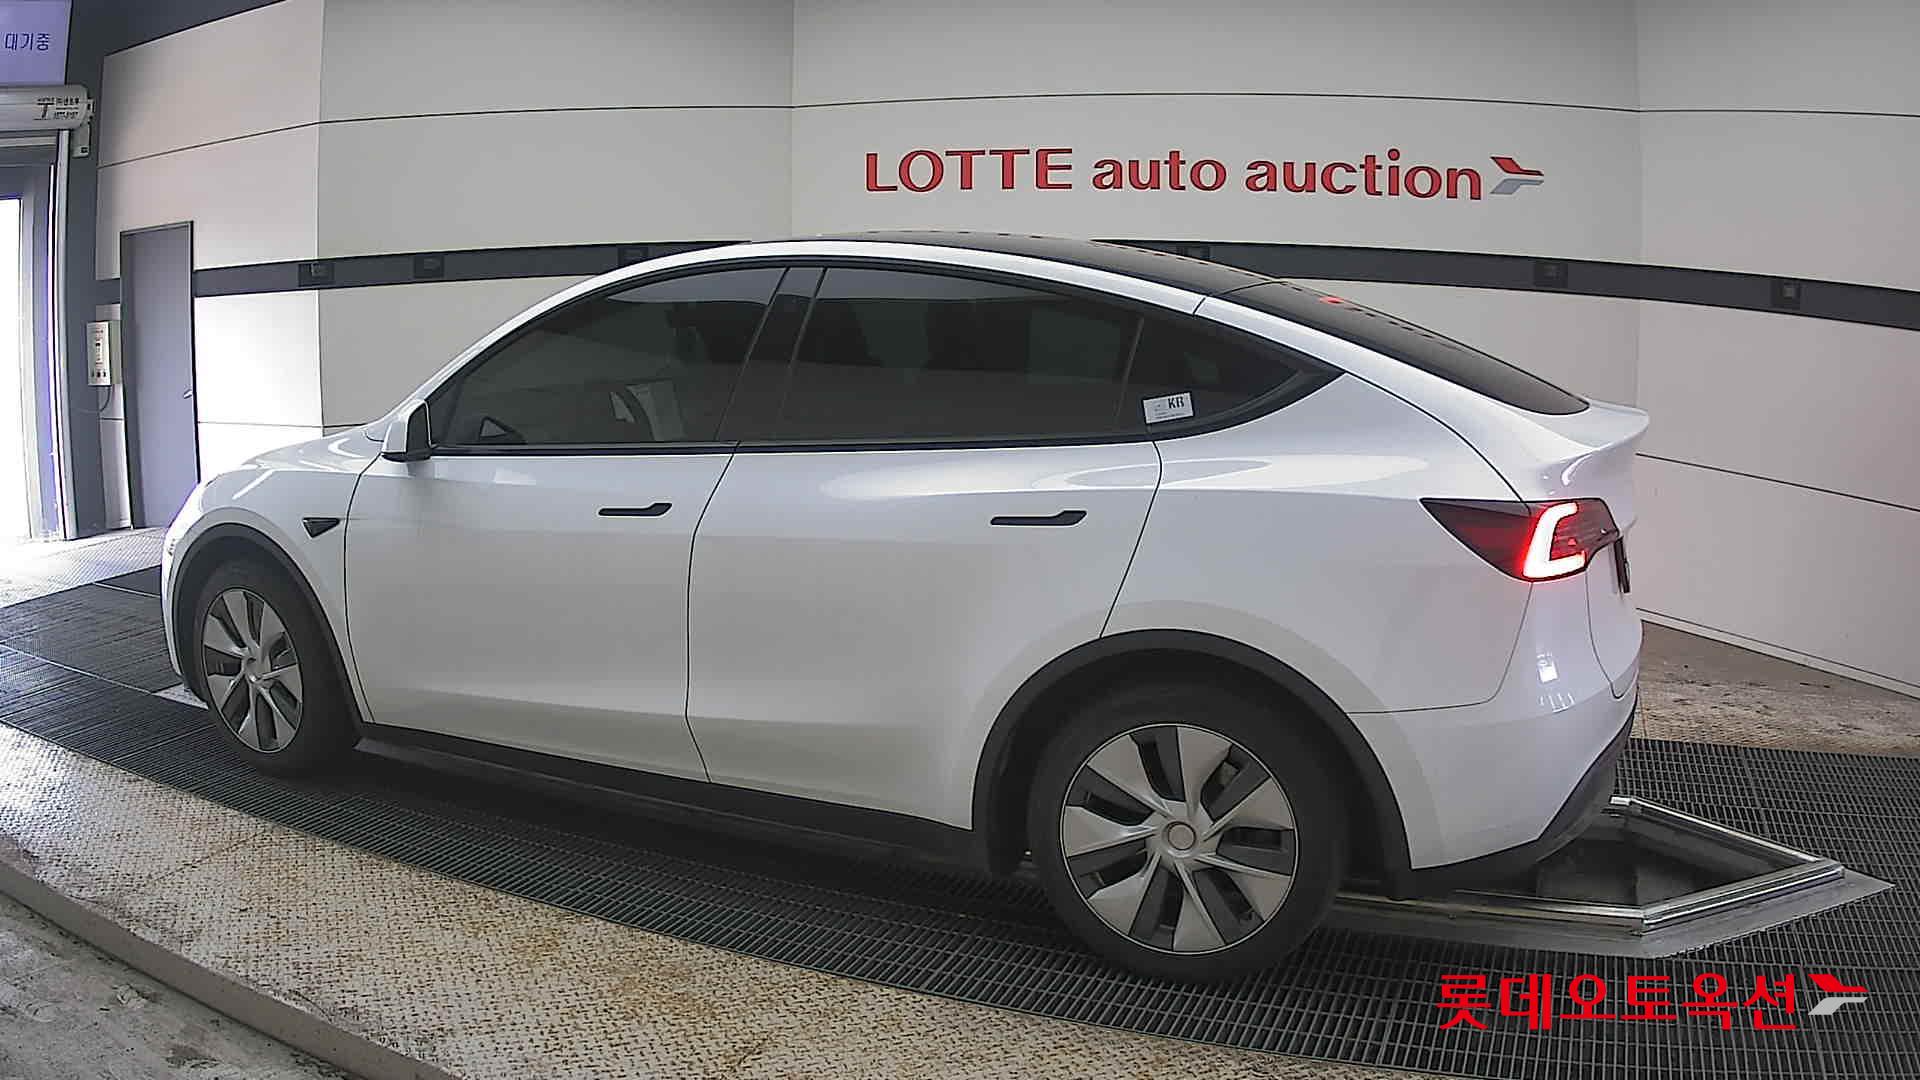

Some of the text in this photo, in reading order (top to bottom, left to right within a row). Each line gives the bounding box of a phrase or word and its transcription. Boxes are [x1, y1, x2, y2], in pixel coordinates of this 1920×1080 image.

[4, 32, 50, 51] 대기중
[866, 148, 1482, 200] LOTTE auto auction
